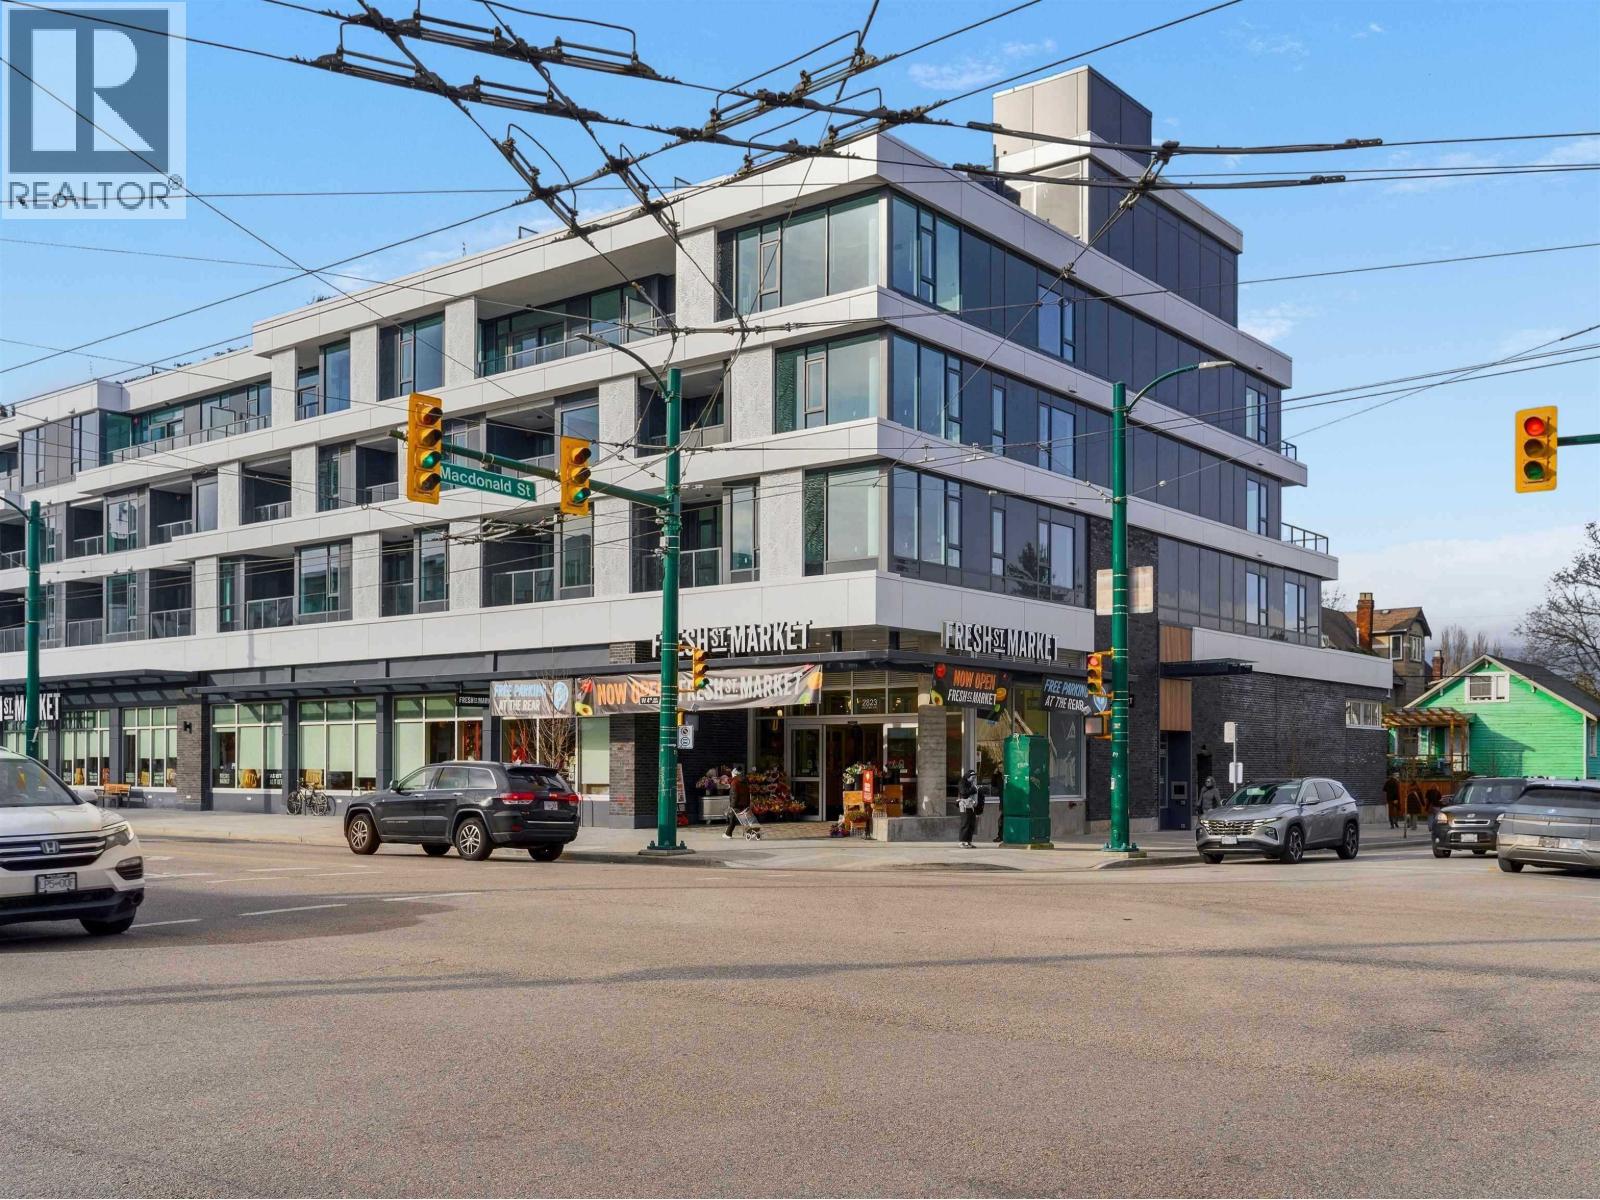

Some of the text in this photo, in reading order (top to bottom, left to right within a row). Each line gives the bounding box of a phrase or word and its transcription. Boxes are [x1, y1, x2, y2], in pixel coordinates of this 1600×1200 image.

[440, 465, 531, 497] Macdonald St
[652, 622, 811, 657] FESH ST. MARKET
[943, 620, 1059, 661] FRESH ST. MARKET
[739, 672, 803, 699] MARKET
[953, 669, 997, 691] NOW OPEN
[1044, 678, 1063, 694] FREE
[522, 699, 541, 711] REAR
[597, 682, 627, 706] NOW
[947, 688, 968, 703] FRESH
[972, 691, 997, 706] MARKET
[1045, 695, 1085, 711] AT THE REAR
[15, 692, 61, 721] MKET
